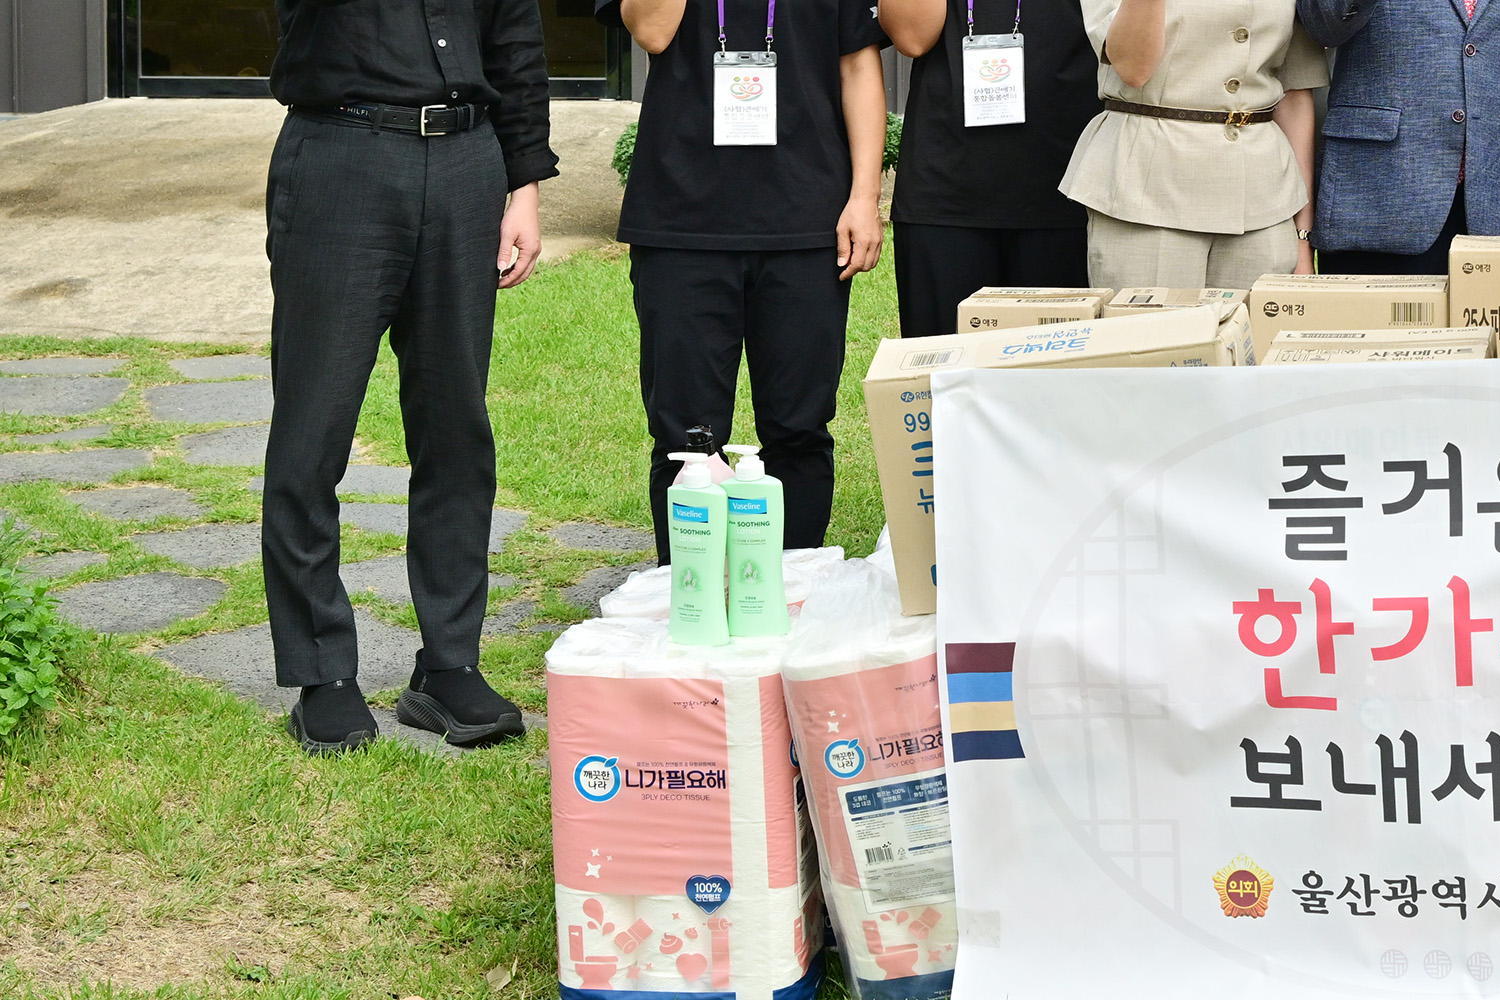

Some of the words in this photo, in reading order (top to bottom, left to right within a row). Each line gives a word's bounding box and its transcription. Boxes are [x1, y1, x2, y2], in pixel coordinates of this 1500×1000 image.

[1475, 264, 1491, 272] 애경
[1281, 304, 1305, 316] 애경
[982, 318, 998, 327] 애경
[1002, 336, 1089, 356] 크리넥스
[732, 502, 761, 510] Vaseline
[676, 508, 702, 518] Vaseline
[680, 528, 711, 536] SOOTHING
[832, 751, 855, 761] 깨끗한
[837, 760, 854, 769] 나라
[583, 770, 610, 781] 깨끗한
[625, 769, 726, 790] 니가필요해
[588, 780, 607, 790] 나라
[694, 883, 722, 893] 100%
[1226, 879, 1259, 899] 의회
